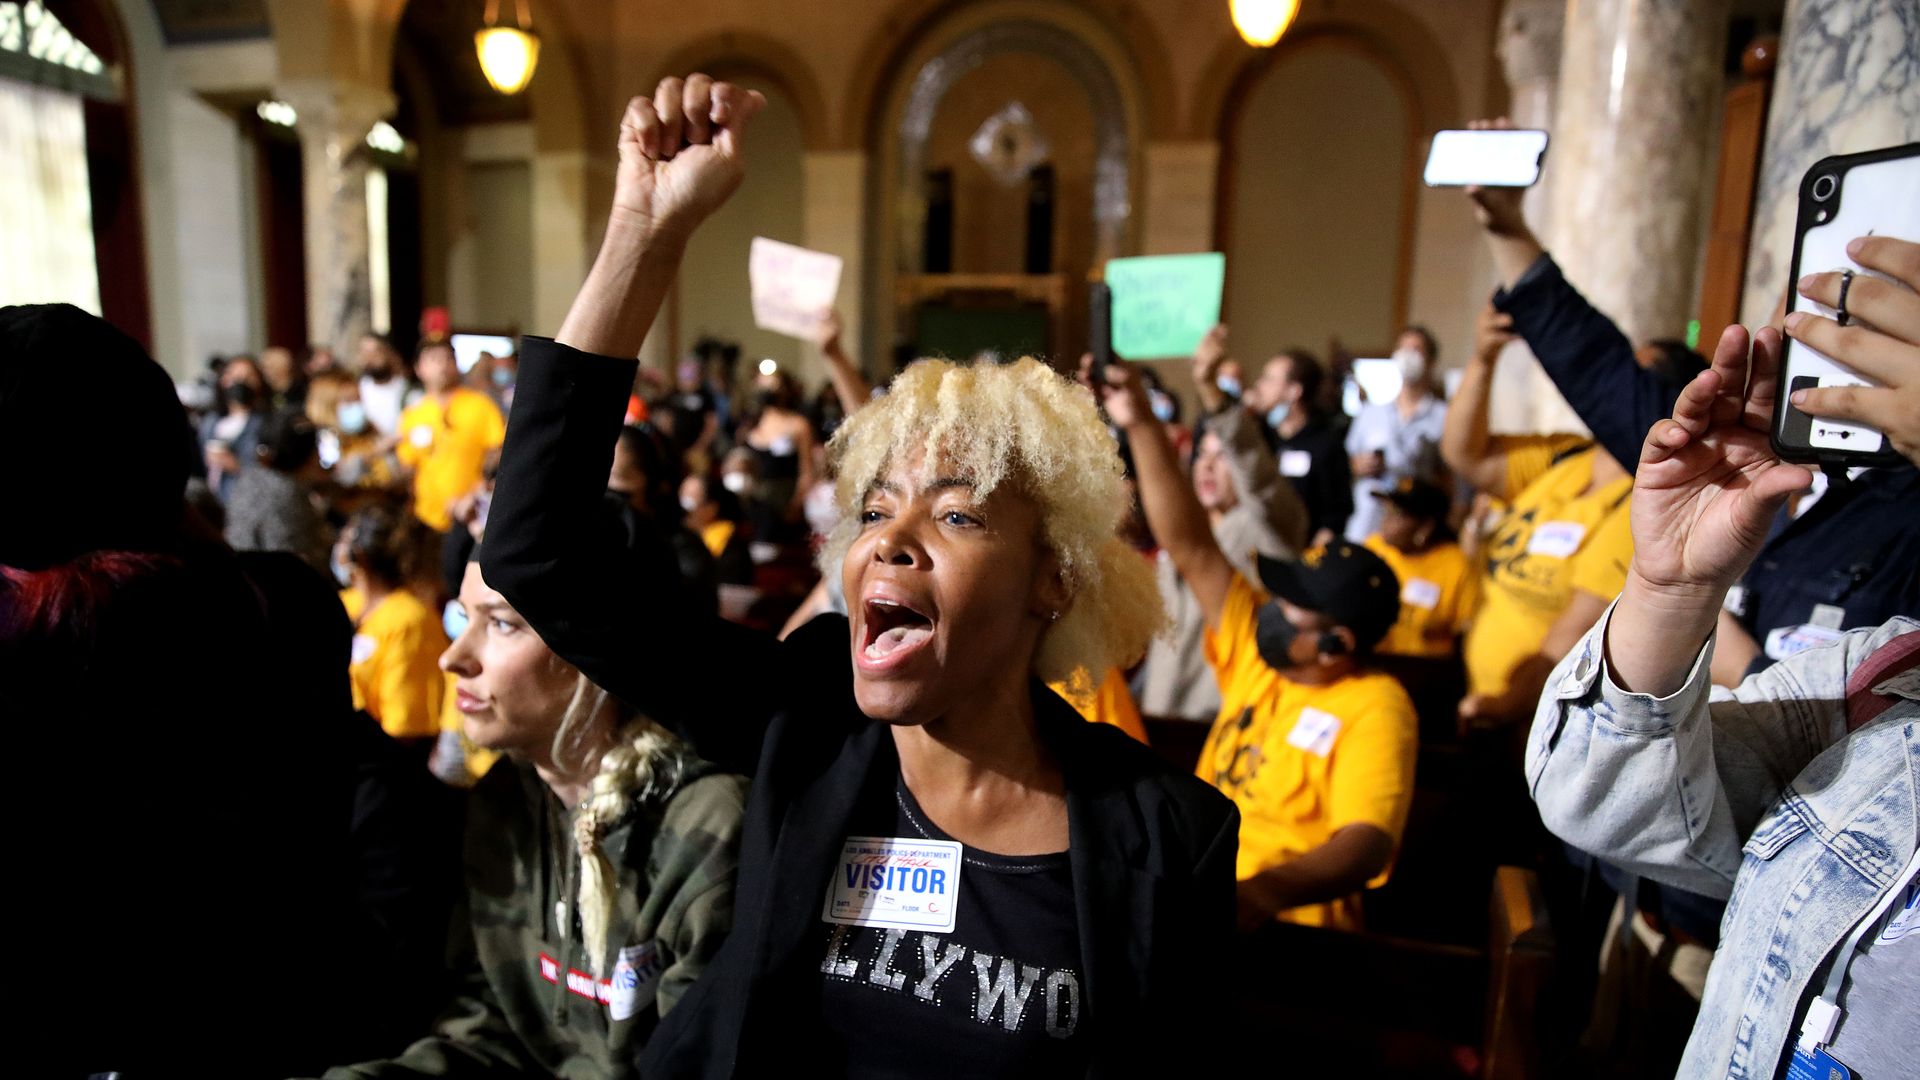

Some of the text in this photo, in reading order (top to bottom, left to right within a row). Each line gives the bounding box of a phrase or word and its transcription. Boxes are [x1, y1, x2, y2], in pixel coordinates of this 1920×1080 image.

[886, 848, 908, 858] POLICE
[910, 850, 951, 860] DEPARTMENT
[845, 862, 946, 895] VISITOR
[902, 904, 920, 913] FLOOR
